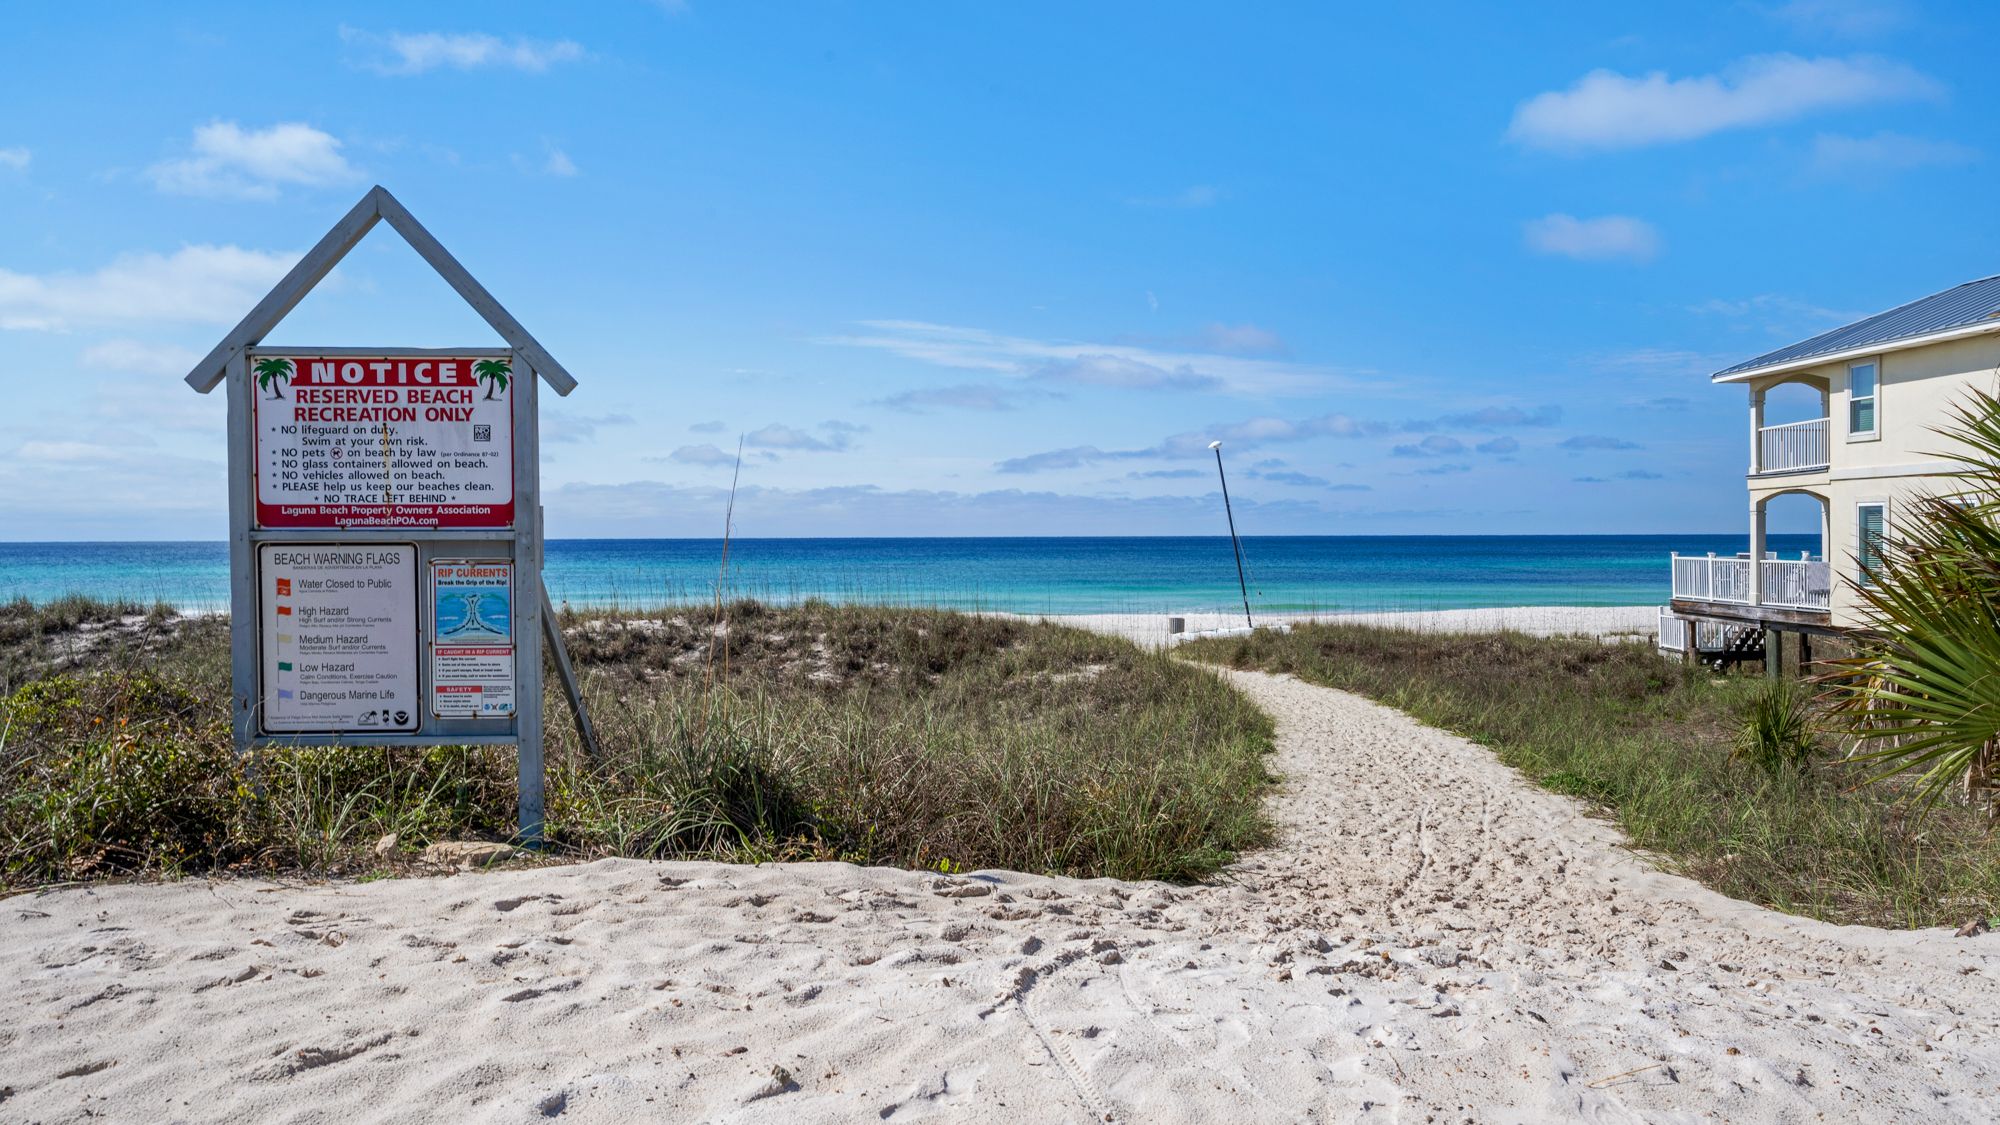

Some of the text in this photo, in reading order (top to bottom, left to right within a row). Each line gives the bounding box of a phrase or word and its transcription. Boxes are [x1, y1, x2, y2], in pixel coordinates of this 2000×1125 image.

[311, 362, 458, 384] NOTICE
[296, 390, 473, 404] RESERVED BEACH
[294, 408, 474, 422] RECREATION ONLY
[281, 426, 297, 434] NO
[302, 425, 349, 436] lifeguard
[370, 425, 398, 436] duty.
[302, 437, 331, 446] Swim
[351, 439, 375, 448] your
[406, 436, 428, 446] risk.
[281, 448, 298, 456] NO
[302, 449, 325, 459] pets
[364, 448, 396, 457] beach
[400, 448, 413, 458] by
[417, 448, 436, 457] law
[281, 460, 298, 468] NO
[302, 459, 328, 470] glass
[332, 460, 387, 468] containers
[391, 459, 433, 468] allowed
[455, 459, 488, 468] beach.
[282, 471, 298, 479] NO
[302, 470, 343, 479] vehicles
[348, 470, 389, 479] allowed
[412, 470, 445, 479] beach.
[282, 482, 319, 491] PLEASE
[323, 482, 346, 492] help
[366, 482, 391, 492] keep
[418, 482, 461, 491] beaches
[464, 482, 494, 491] clean.
[324, 494, 447, 503] NO TRACE LEFT BEHIND
[282, 506, 490, 516] Laguna Beach Property Owners Association
[335, 517, 438, 527] LagunaBeachPOA.com
[274, 553, 400, 565] BEACH WARNING FLAGS
[438, 568, 507, 577] RIP CURRENTS
[299, 580, 322, 588] Water
[326, 579, 354, 588] Closed
[368, 579, 391, 588] Public
[299, 607, 349, 617] High Hazard
[299, 635, 368, 644] Medium Hazard
[322, 663, 354, 671] Hazard
[300, 690, 394, 701] Dangerous Marine Life
